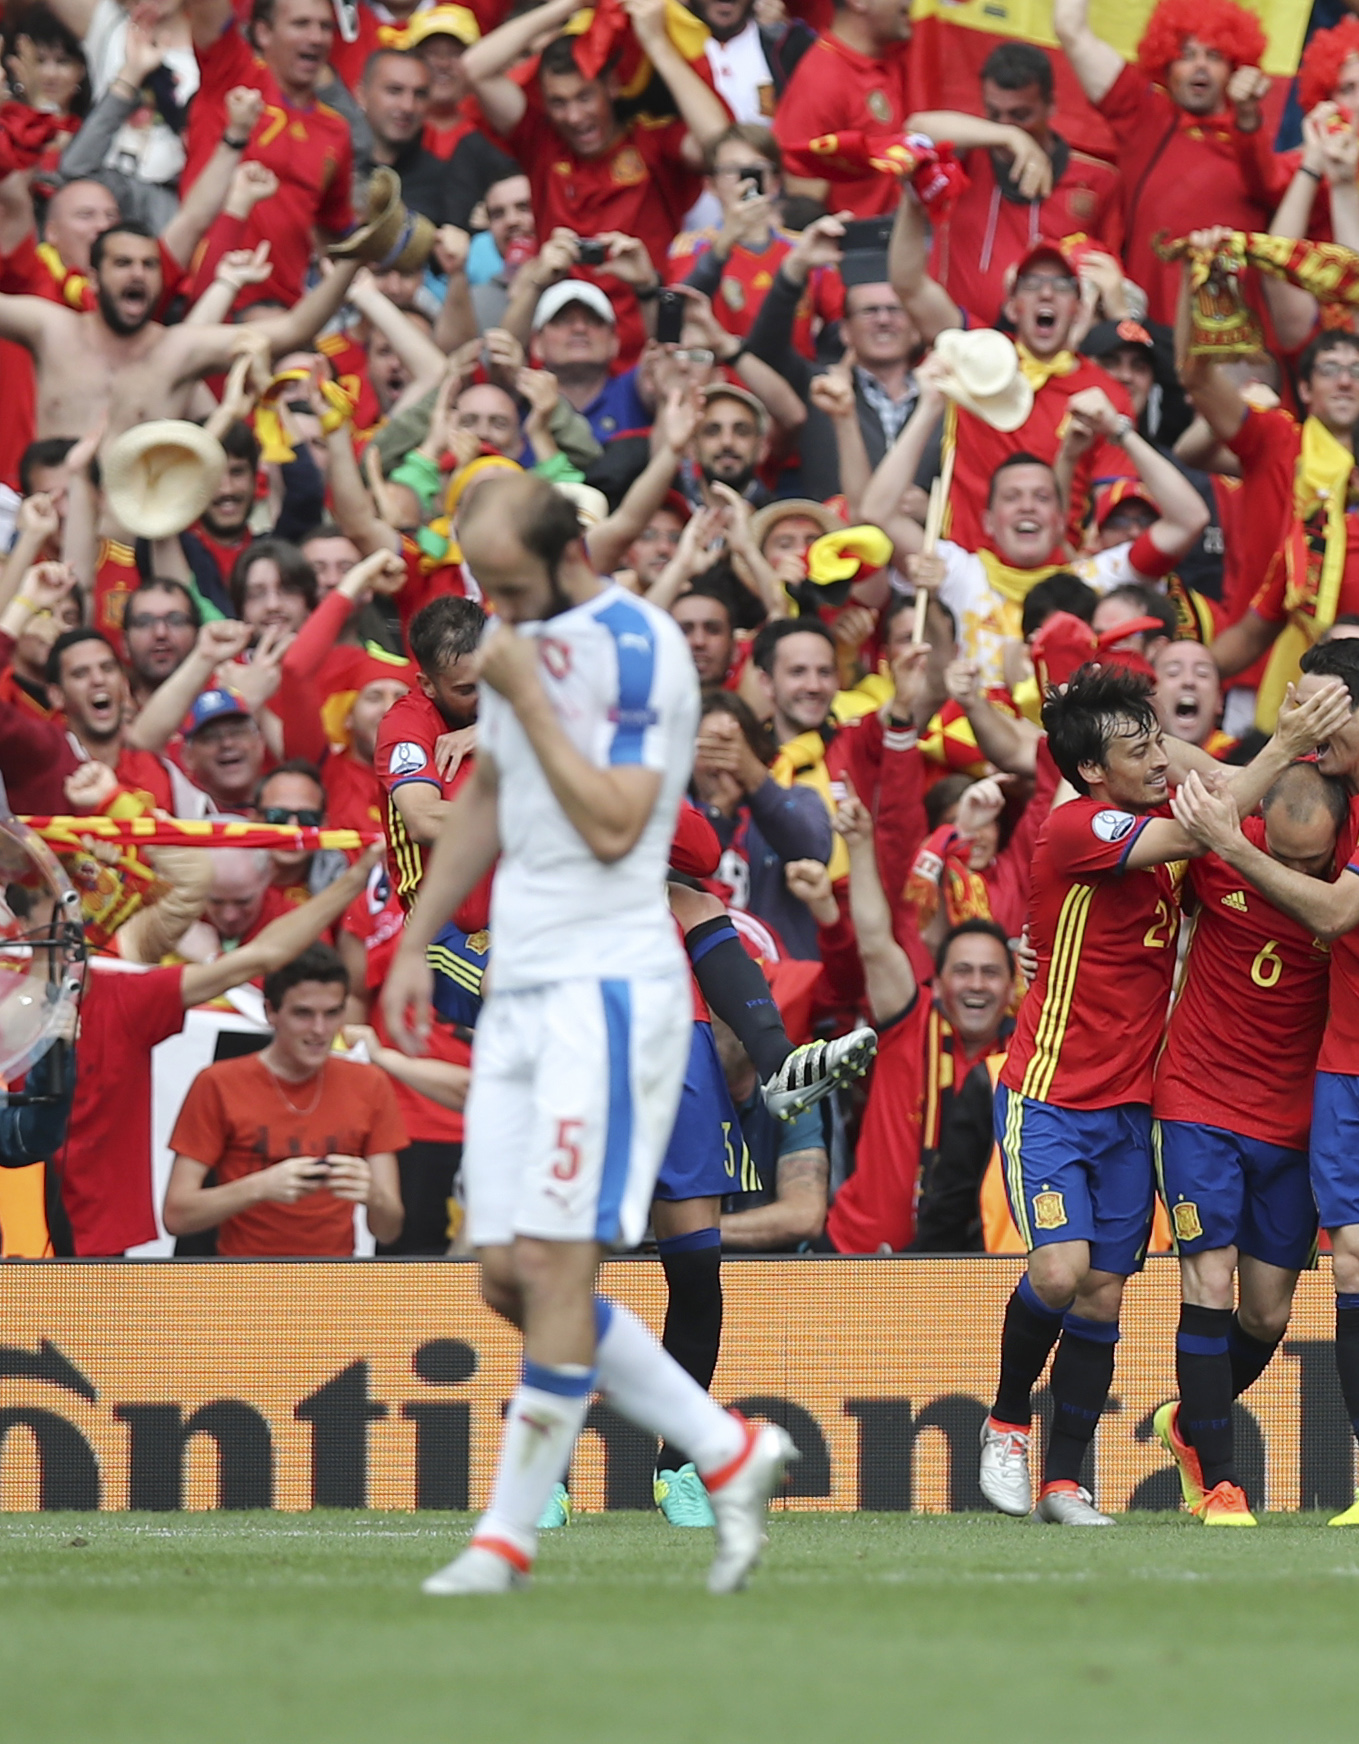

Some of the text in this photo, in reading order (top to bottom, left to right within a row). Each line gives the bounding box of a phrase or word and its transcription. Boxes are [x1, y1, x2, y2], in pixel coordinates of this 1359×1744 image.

[1251, 939, 1283, 988] 6
[552, 1118, 585, 1181] 5
[721, 1121, 735, 1178] 3
[0, 1335, 1356, 1511] ontinental
